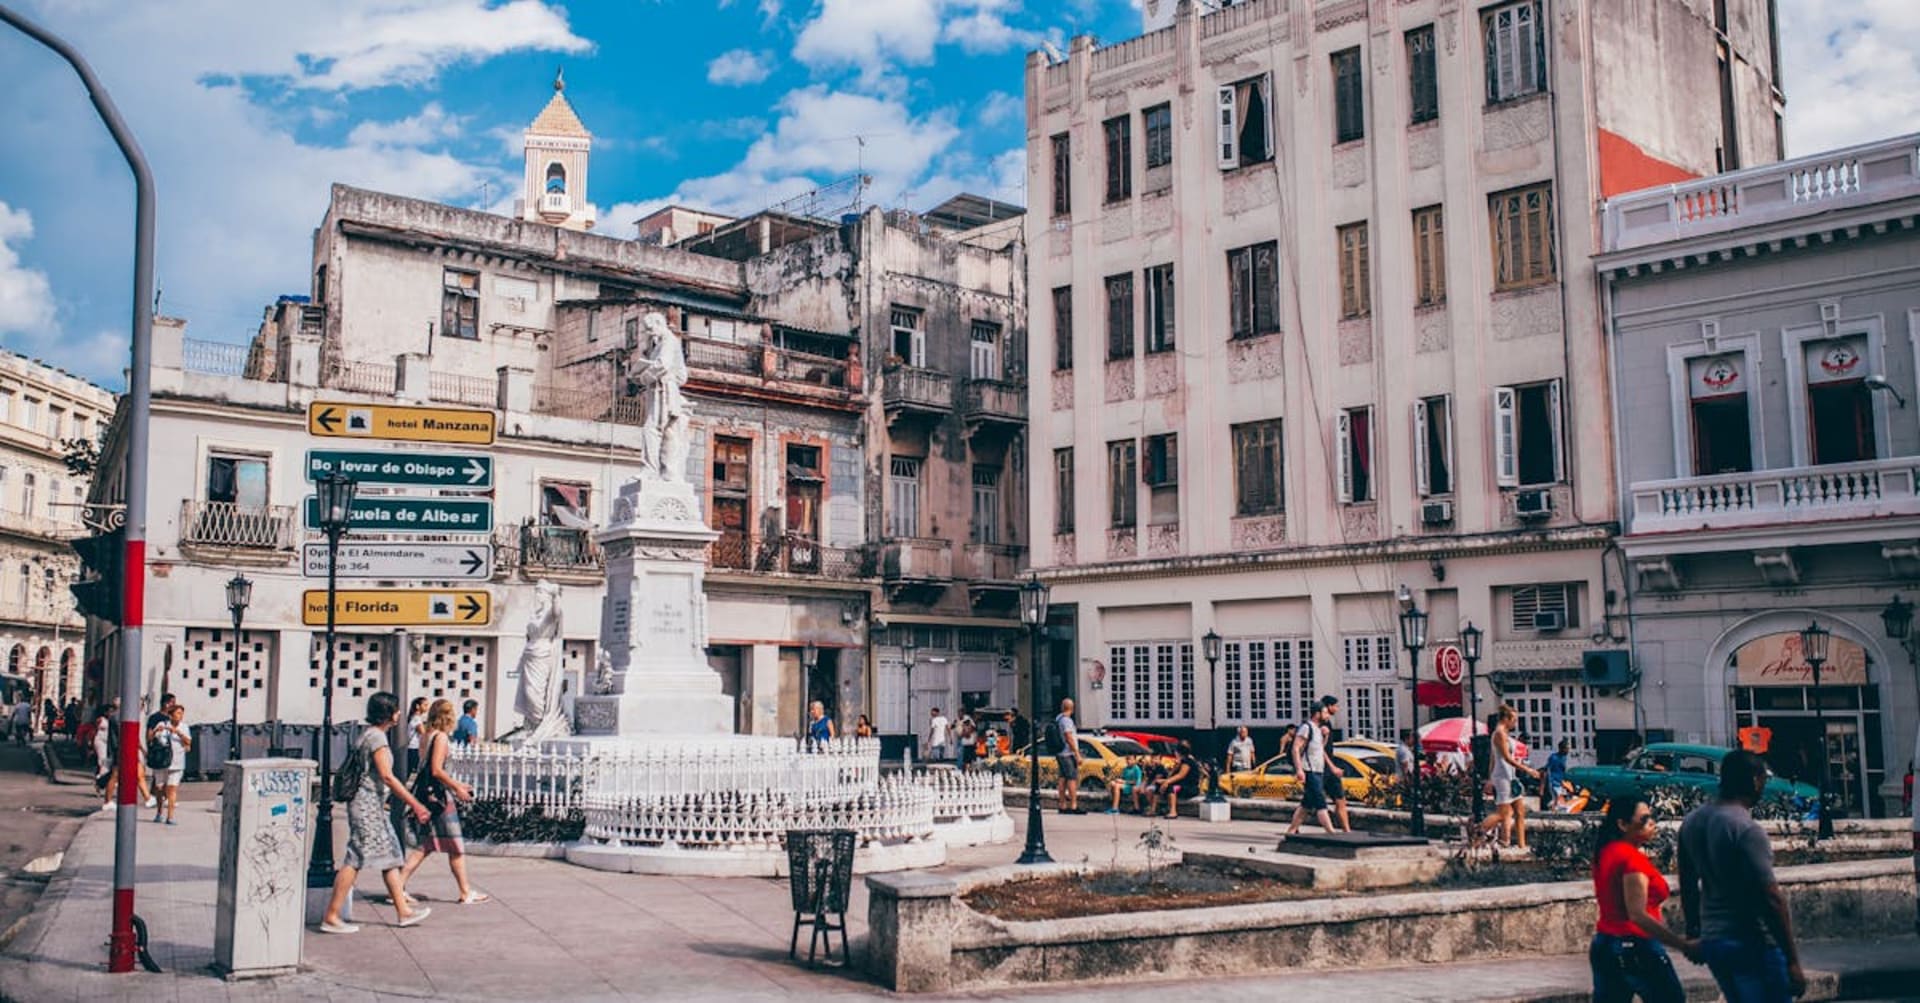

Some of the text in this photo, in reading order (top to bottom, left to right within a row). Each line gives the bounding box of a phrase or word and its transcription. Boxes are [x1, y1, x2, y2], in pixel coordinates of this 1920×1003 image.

[387, 418, 489, 432] hotel Manzana
[311, 458, 455, 478] Bolevar de Obispo
[395, 507, 417, 522] de
[349, 549, 360, 557] El
[363, 549, 425, 558] Almendares
[350, 563, 370, 571] 364
[308, 601, 399, 613] hotl Florida
